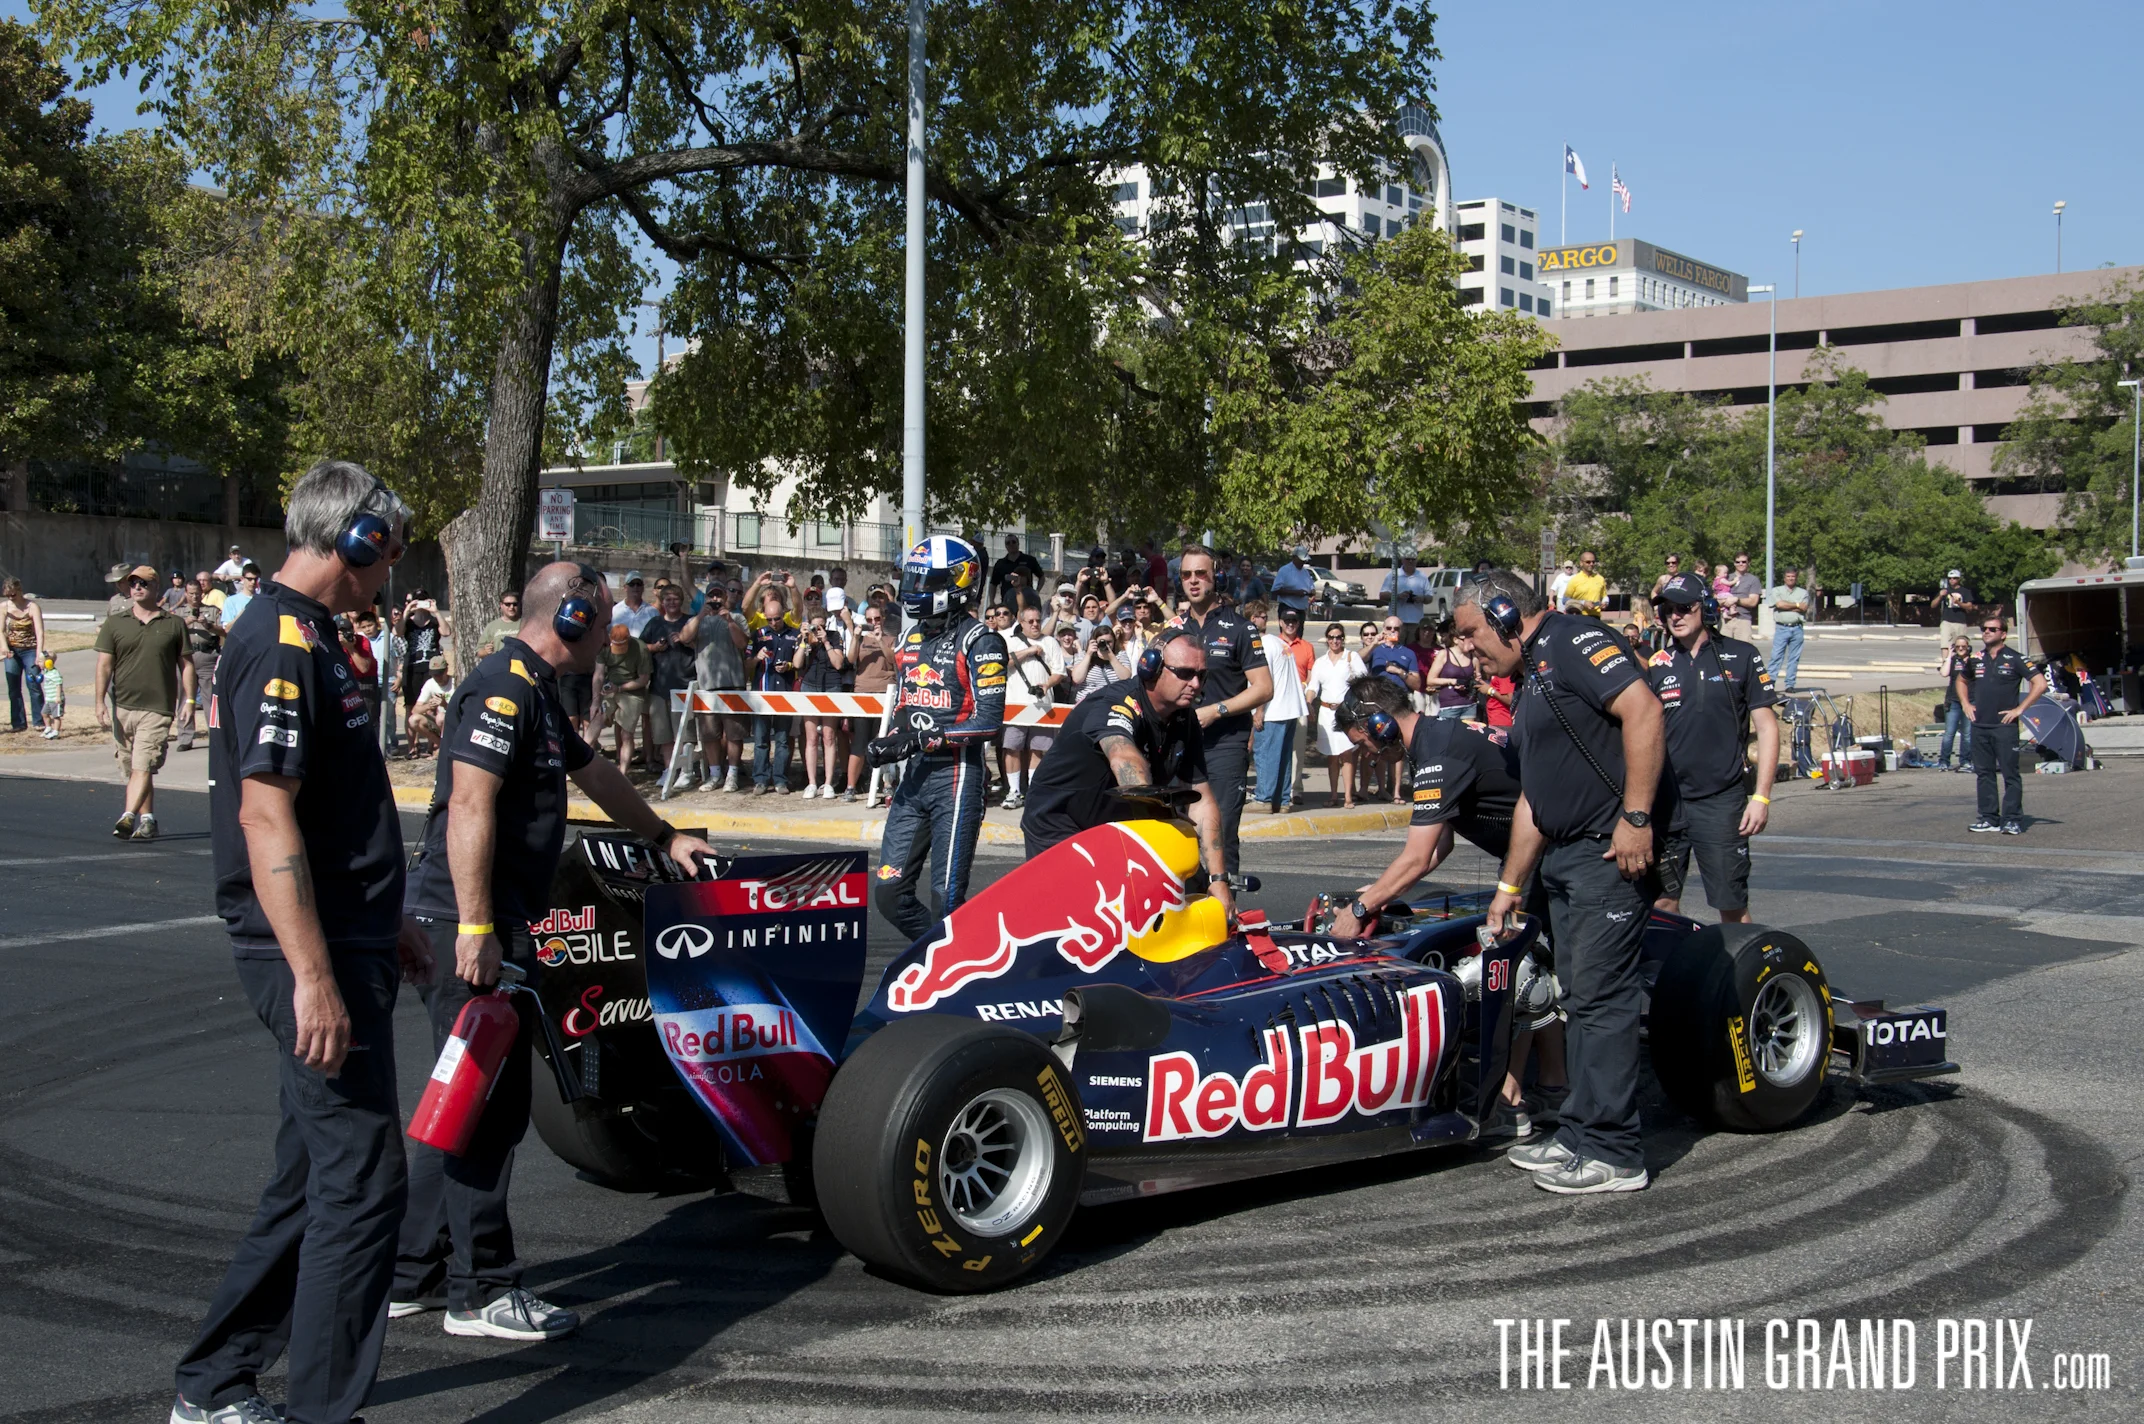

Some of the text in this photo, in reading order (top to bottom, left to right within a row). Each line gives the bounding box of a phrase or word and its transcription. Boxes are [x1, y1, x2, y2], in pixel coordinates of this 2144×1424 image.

[1656, 252, 1730, 293] WELLS FARGO
[542, 505, 571, 515] PARKING
[550, 494, 563, 504] NO
[550, 515, 563, 523] ANY
[1572, 630, 1604, 645] CASIO
[974, 652, 1003, 662] CASIO
[1600, 656, 1628, 674] GEOX
[2043, 663, 2056, 694] TOTA
[920, 687, 951, 709] Bull
[978, 687, 1005, 696] GEOX
[346, 712, 369, 729] GEO
[264, 728, 296, 743] FXDD
[480, 734, 509, 752] FXDD
[739, 881, 860, 911] TOTAL
[528, 904, 596, 935] ed Bull
[727, 921, 859, 949] INFINITI
[1487, 959, 1510, 992] 31
[1803, 960, 1819, 976] P
[975, 999, 1064, 1022] RENA
[663, 1010, 798, 1057] Red Bull
[1866, 1017, 1946, 1046] TOTAL
[1143, 983, 1445, 1142] Red Bull
[1727, 1015, 1757, 1094] PIRELLI
[703, 1063, 764, 1085] COLA
[1089, 1075, 1143, 1088] SIEMENS
[1036, 1064, 1085, 1153] PIRELLI
[913, 1137, 993, 1272] P ZERO
[992, 1211, 1013, 1226] OZ
